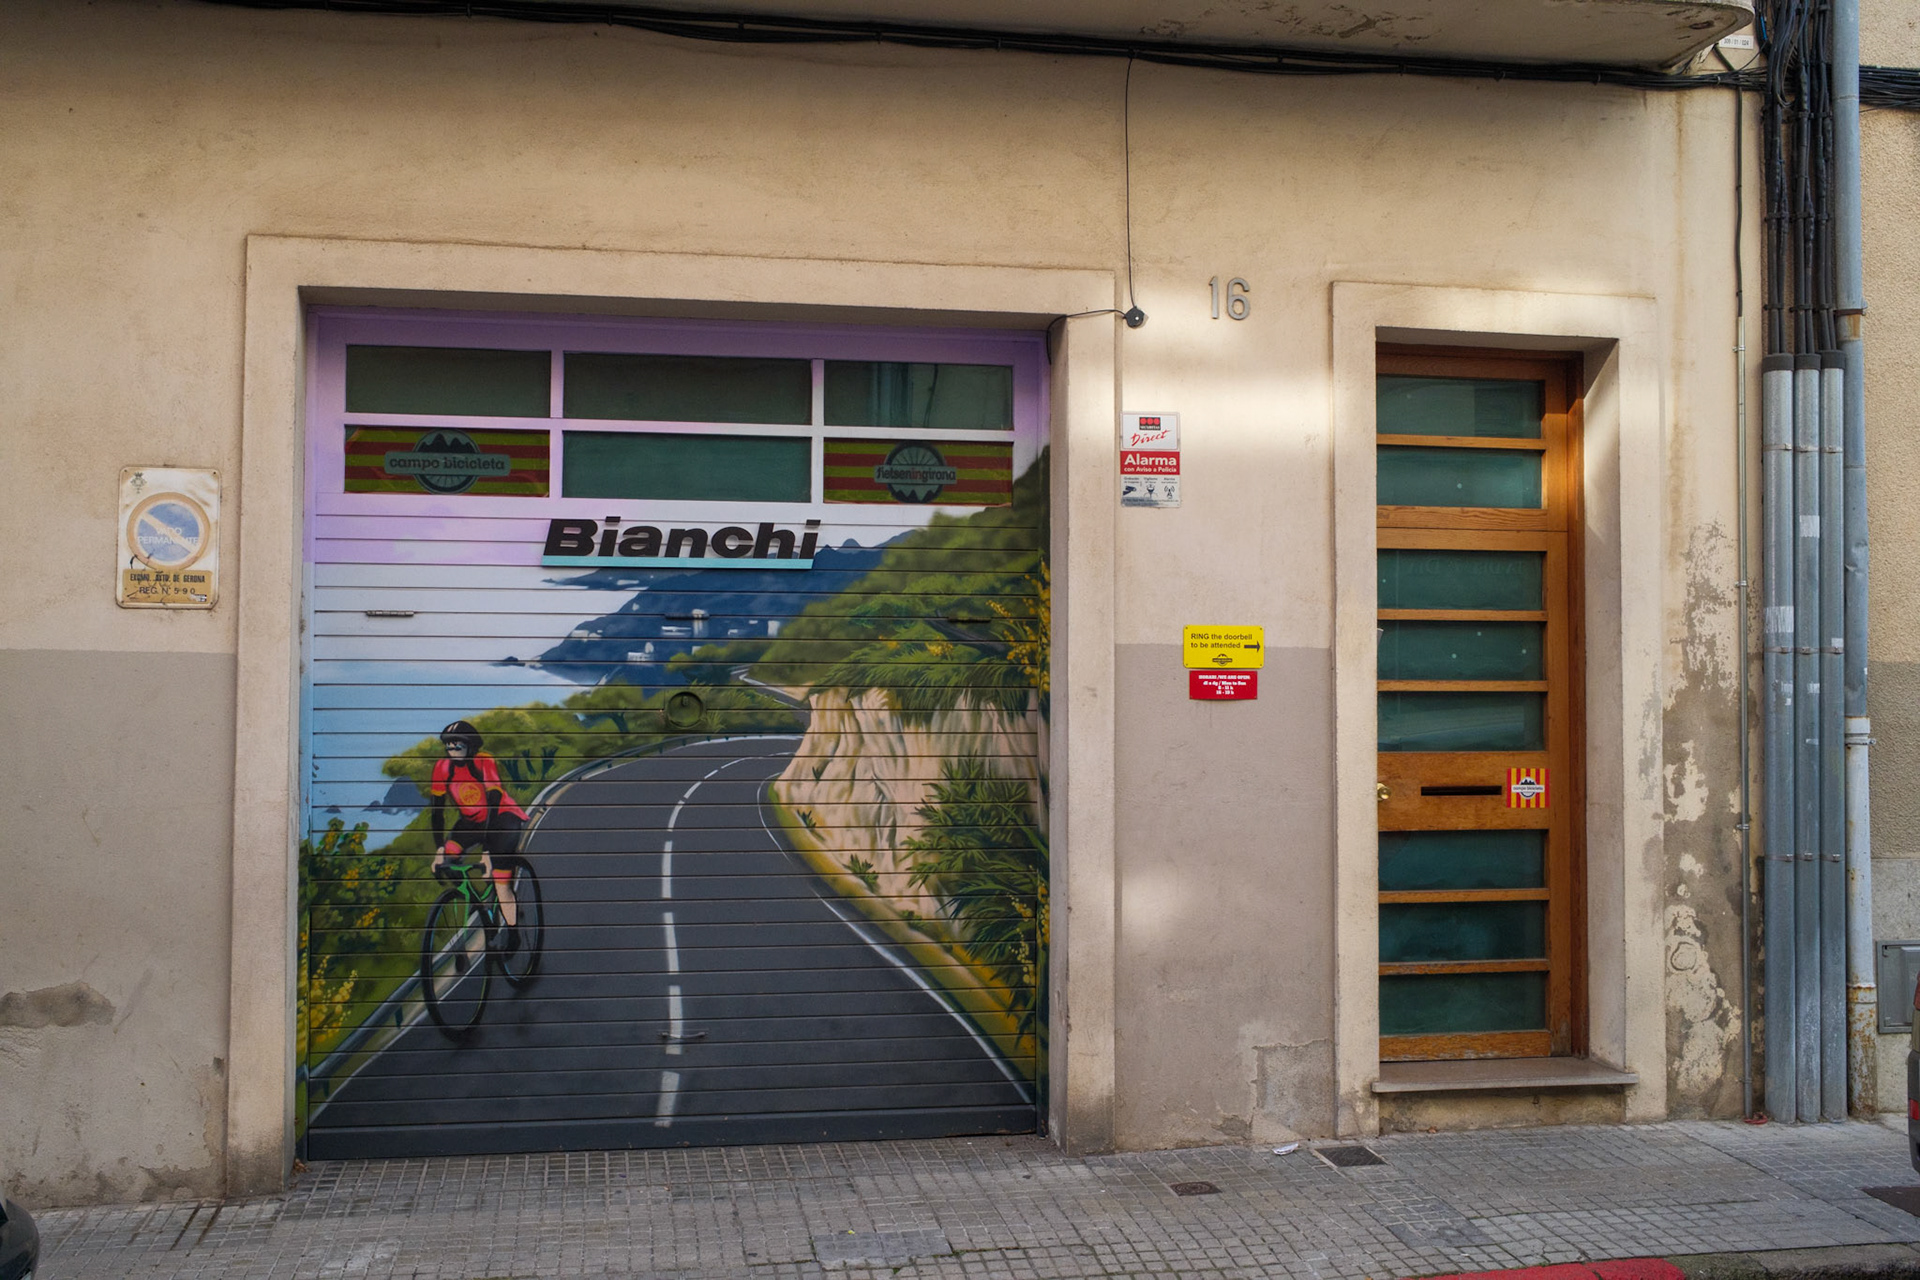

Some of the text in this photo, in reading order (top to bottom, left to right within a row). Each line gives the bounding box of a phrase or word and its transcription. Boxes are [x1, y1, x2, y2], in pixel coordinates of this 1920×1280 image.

[1208, 276, 1251, 321] 16
[1131, 430, 1171, 446] Direct
[389, 456, 505, 471] campo bicicleta
[1124, 454, 1177, 466] Alarma
[876, 467, 956, 482] fietseningirona
[543, 516, 821, 559] Bianchi
[173, 574, 180, 582] DE
[184, 574, 205, 582] GERONA
